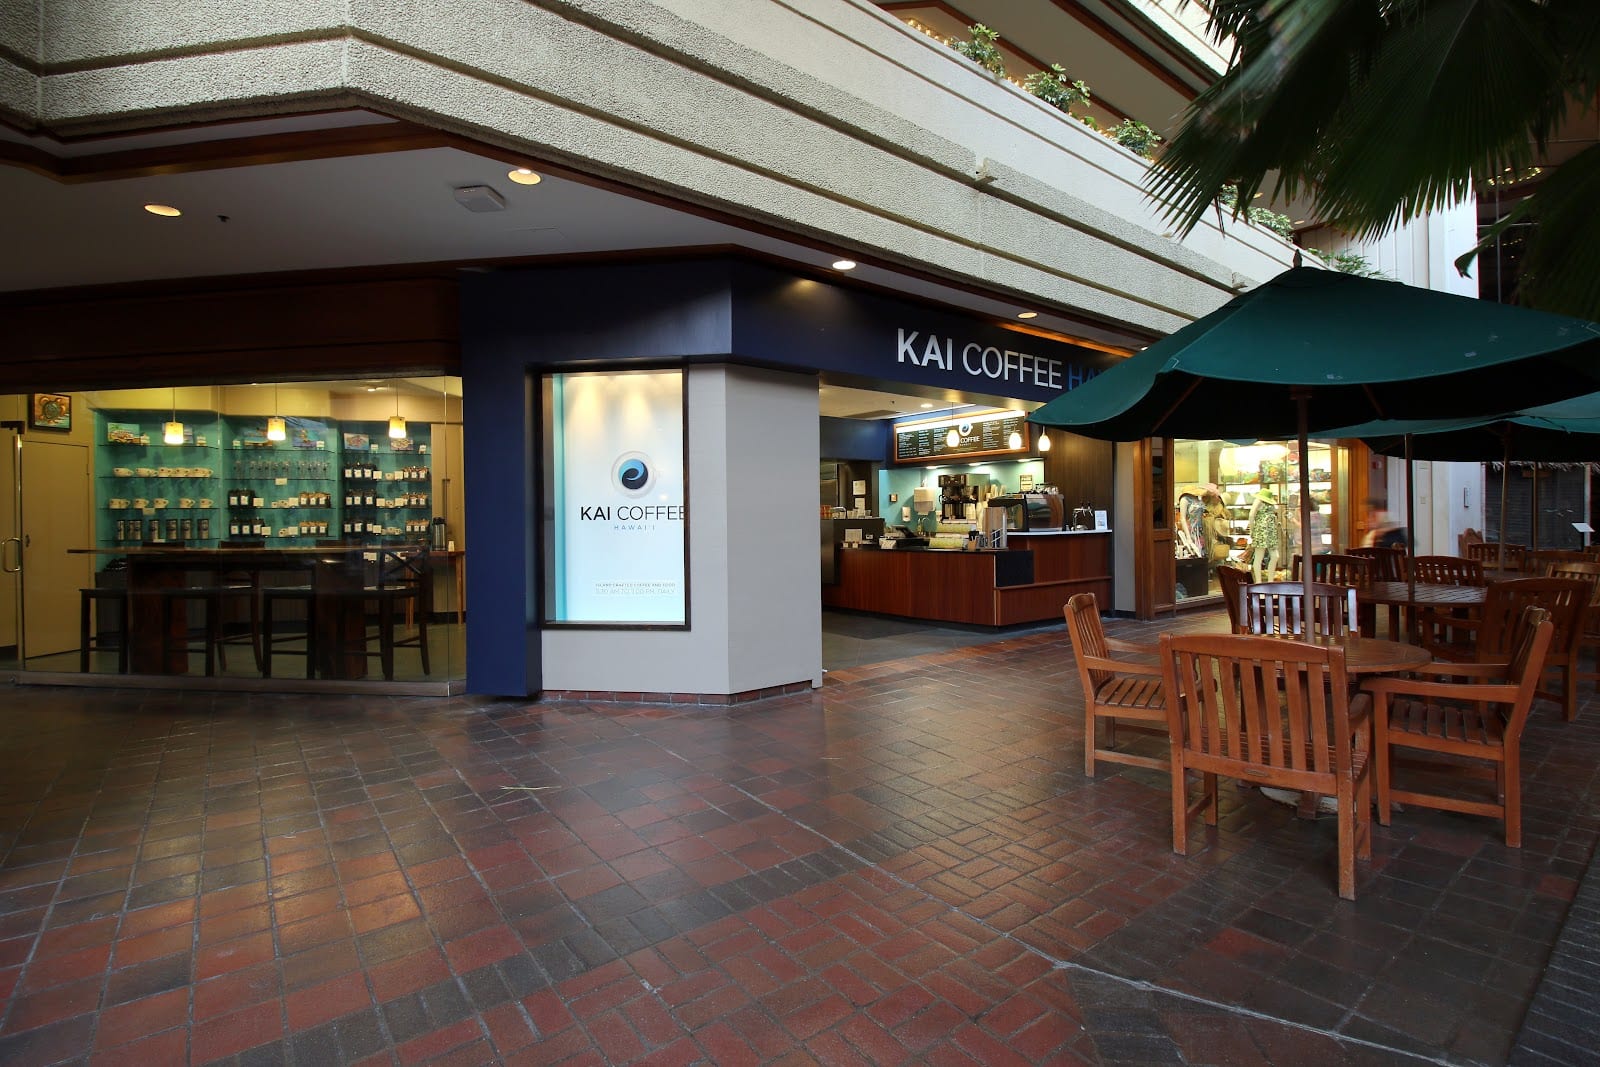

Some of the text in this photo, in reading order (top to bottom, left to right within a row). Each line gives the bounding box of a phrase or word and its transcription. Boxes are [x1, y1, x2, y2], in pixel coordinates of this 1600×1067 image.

[897, 328, 953, 371] KAI
[962, 342, 1063, 390] COFFEE
[580, 505, 685, 521] KAI COFFEE
